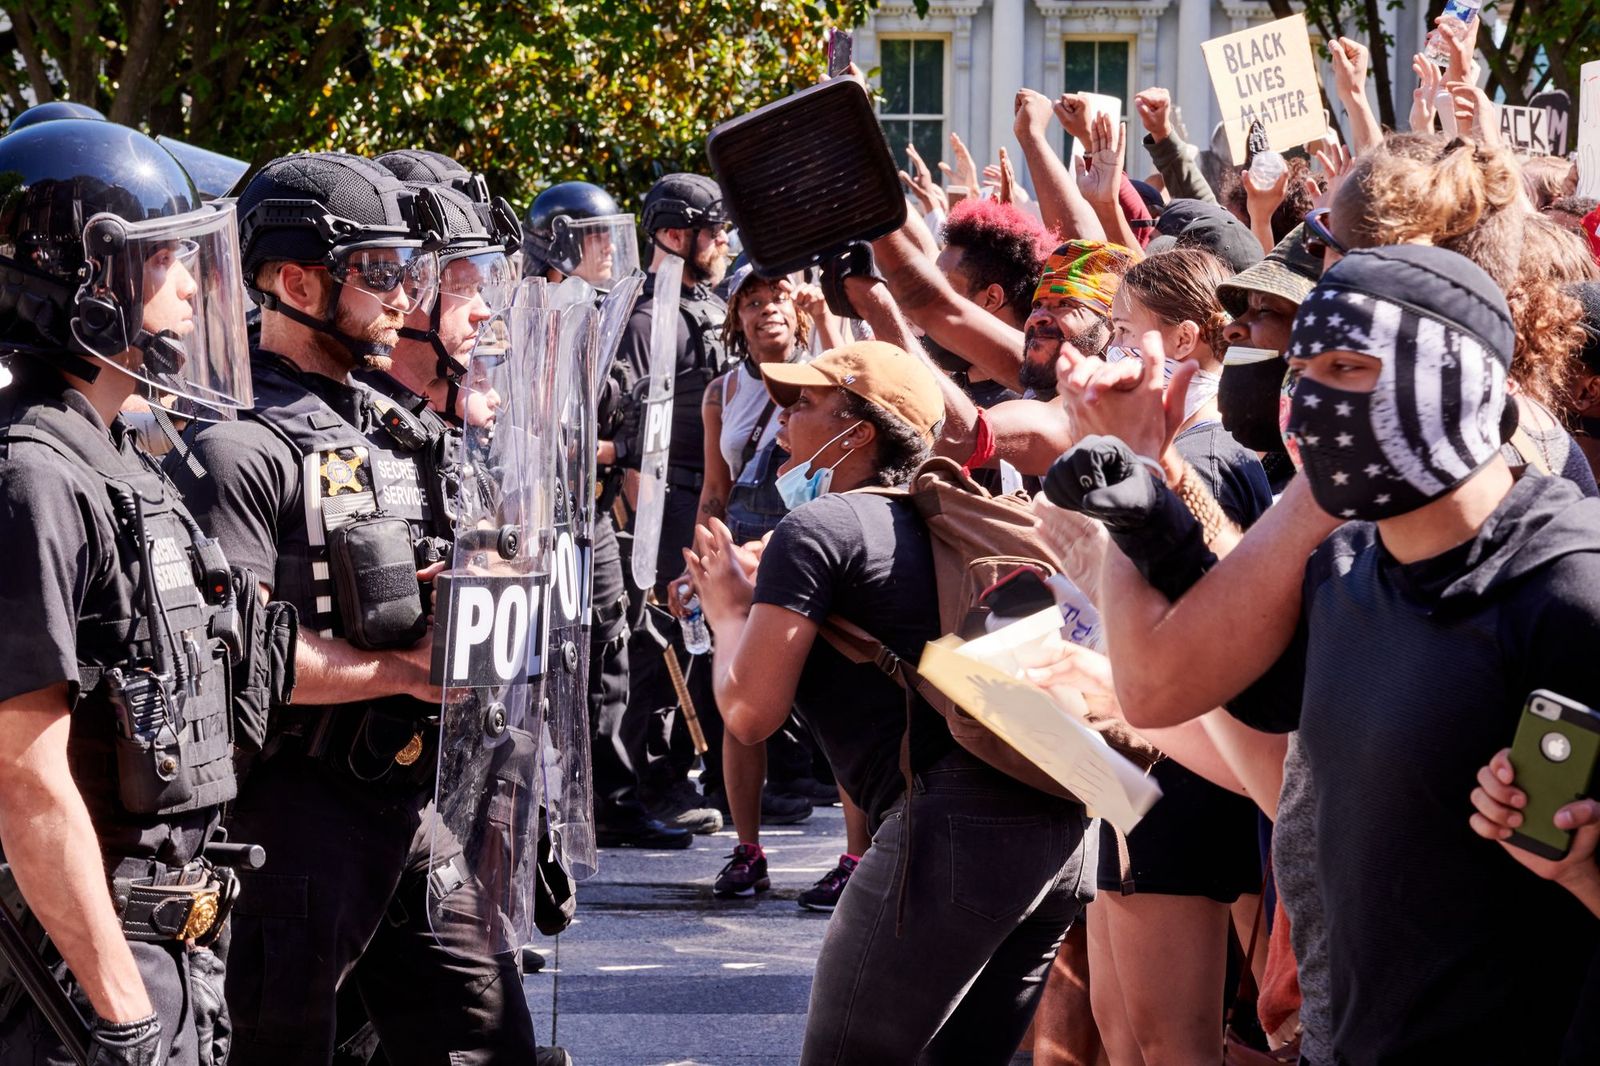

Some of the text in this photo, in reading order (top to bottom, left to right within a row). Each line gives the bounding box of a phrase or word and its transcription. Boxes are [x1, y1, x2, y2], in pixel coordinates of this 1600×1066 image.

[1222, 31, 1286, 75] BLACK
[1235, 66, 1286, 99] LIVES
[1240, 89, 1309, 131] MATTER
[377, 460, 420, 481] SECRET
[382, 485, 428, 506] SERVICE
